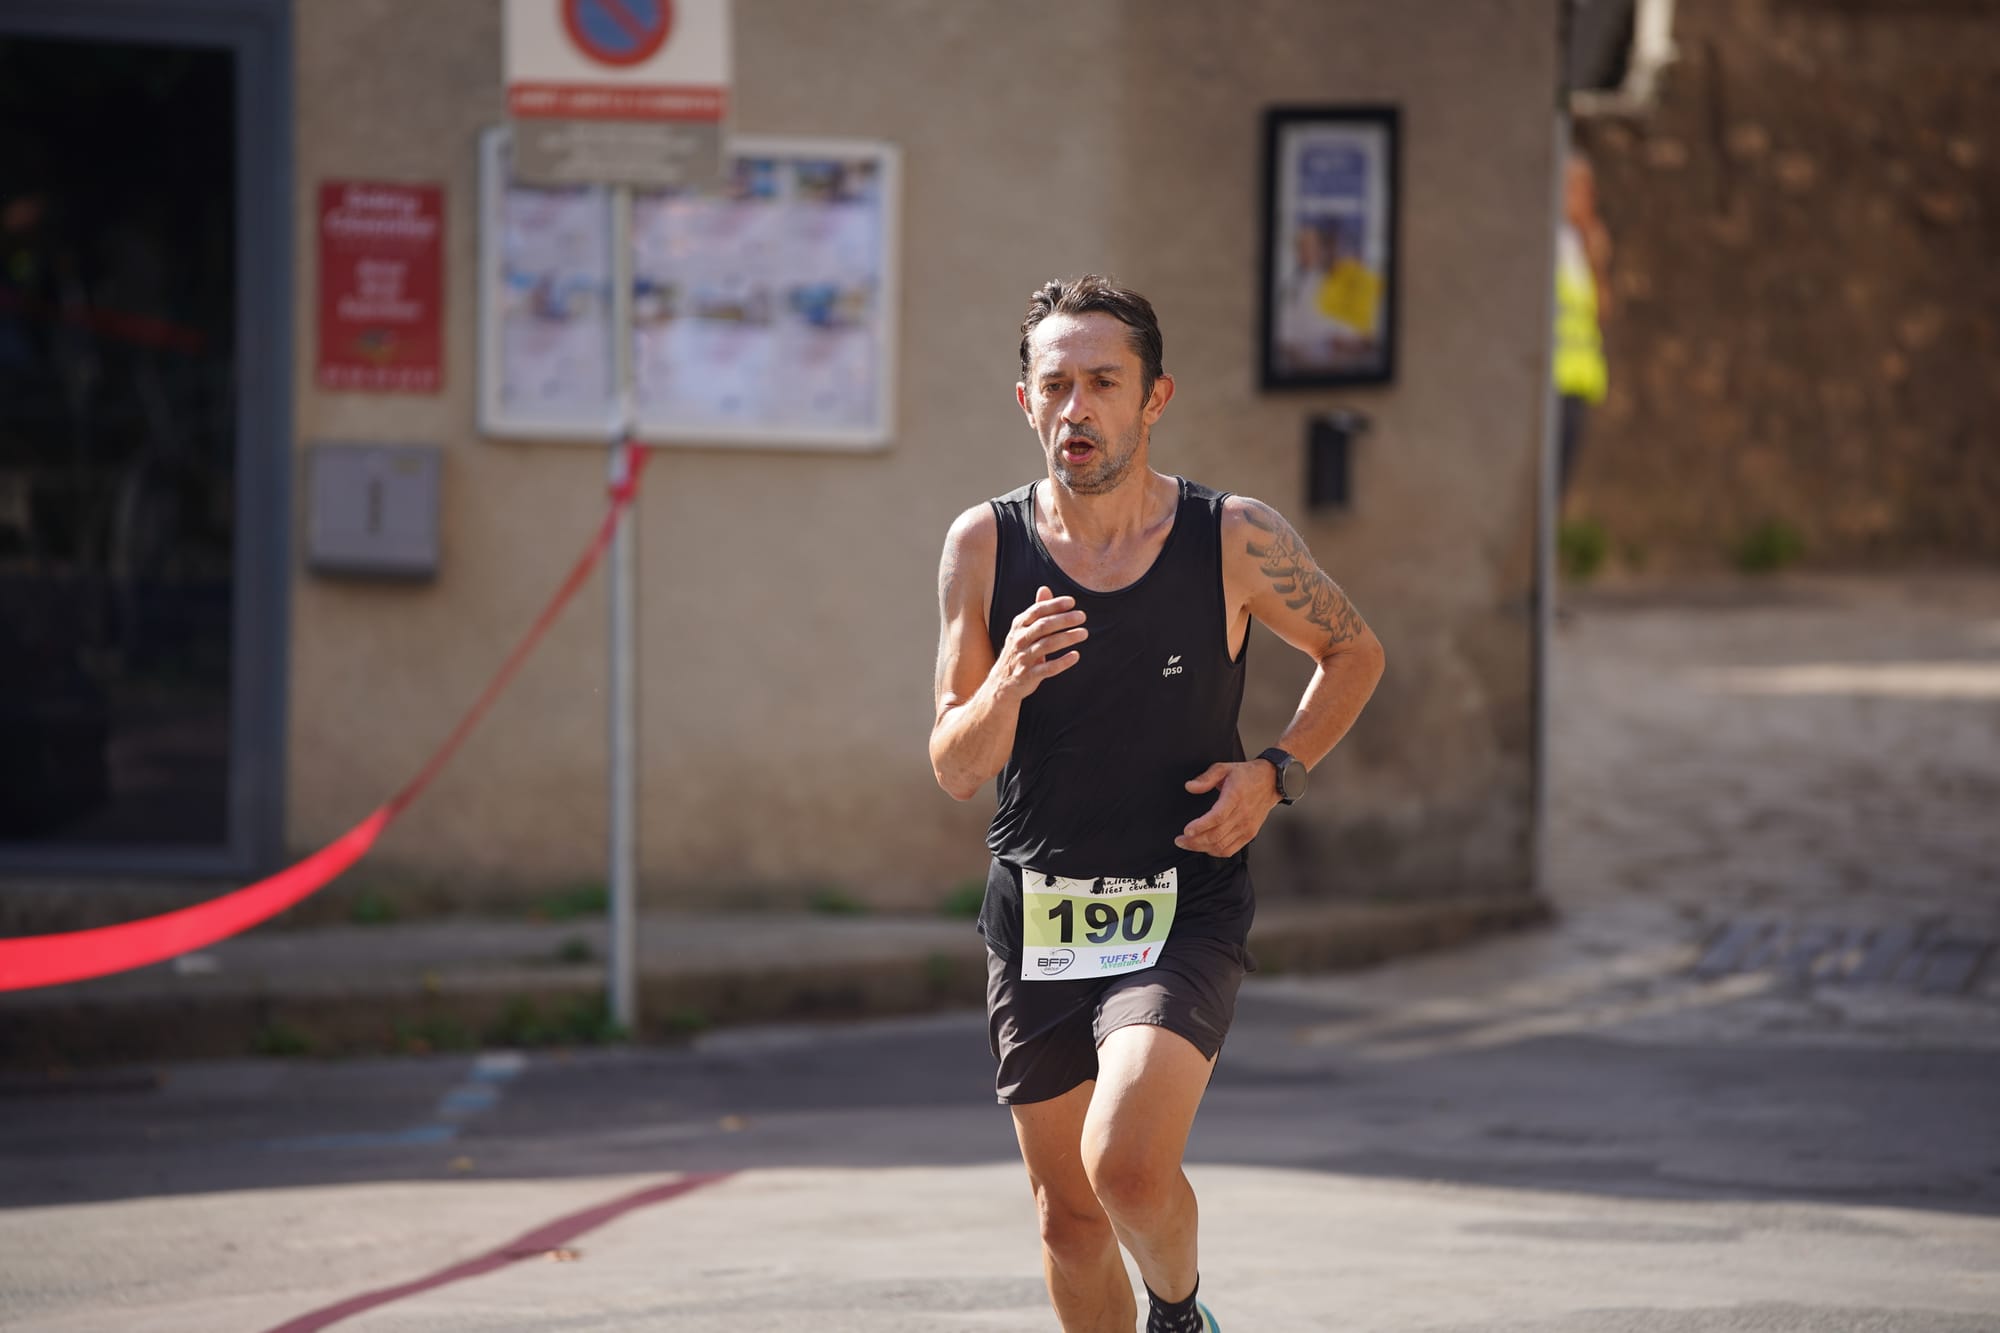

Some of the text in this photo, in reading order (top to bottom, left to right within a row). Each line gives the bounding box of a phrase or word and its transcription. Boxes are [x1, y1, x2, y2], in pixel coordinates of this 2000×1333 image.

[1162, 666, 1183, 678] ipso
[1049, 900, 1154, 944] 190
[1037, 958, 1070, 967] BFP
[1100, 953, 1138, 964] TUFF'S
